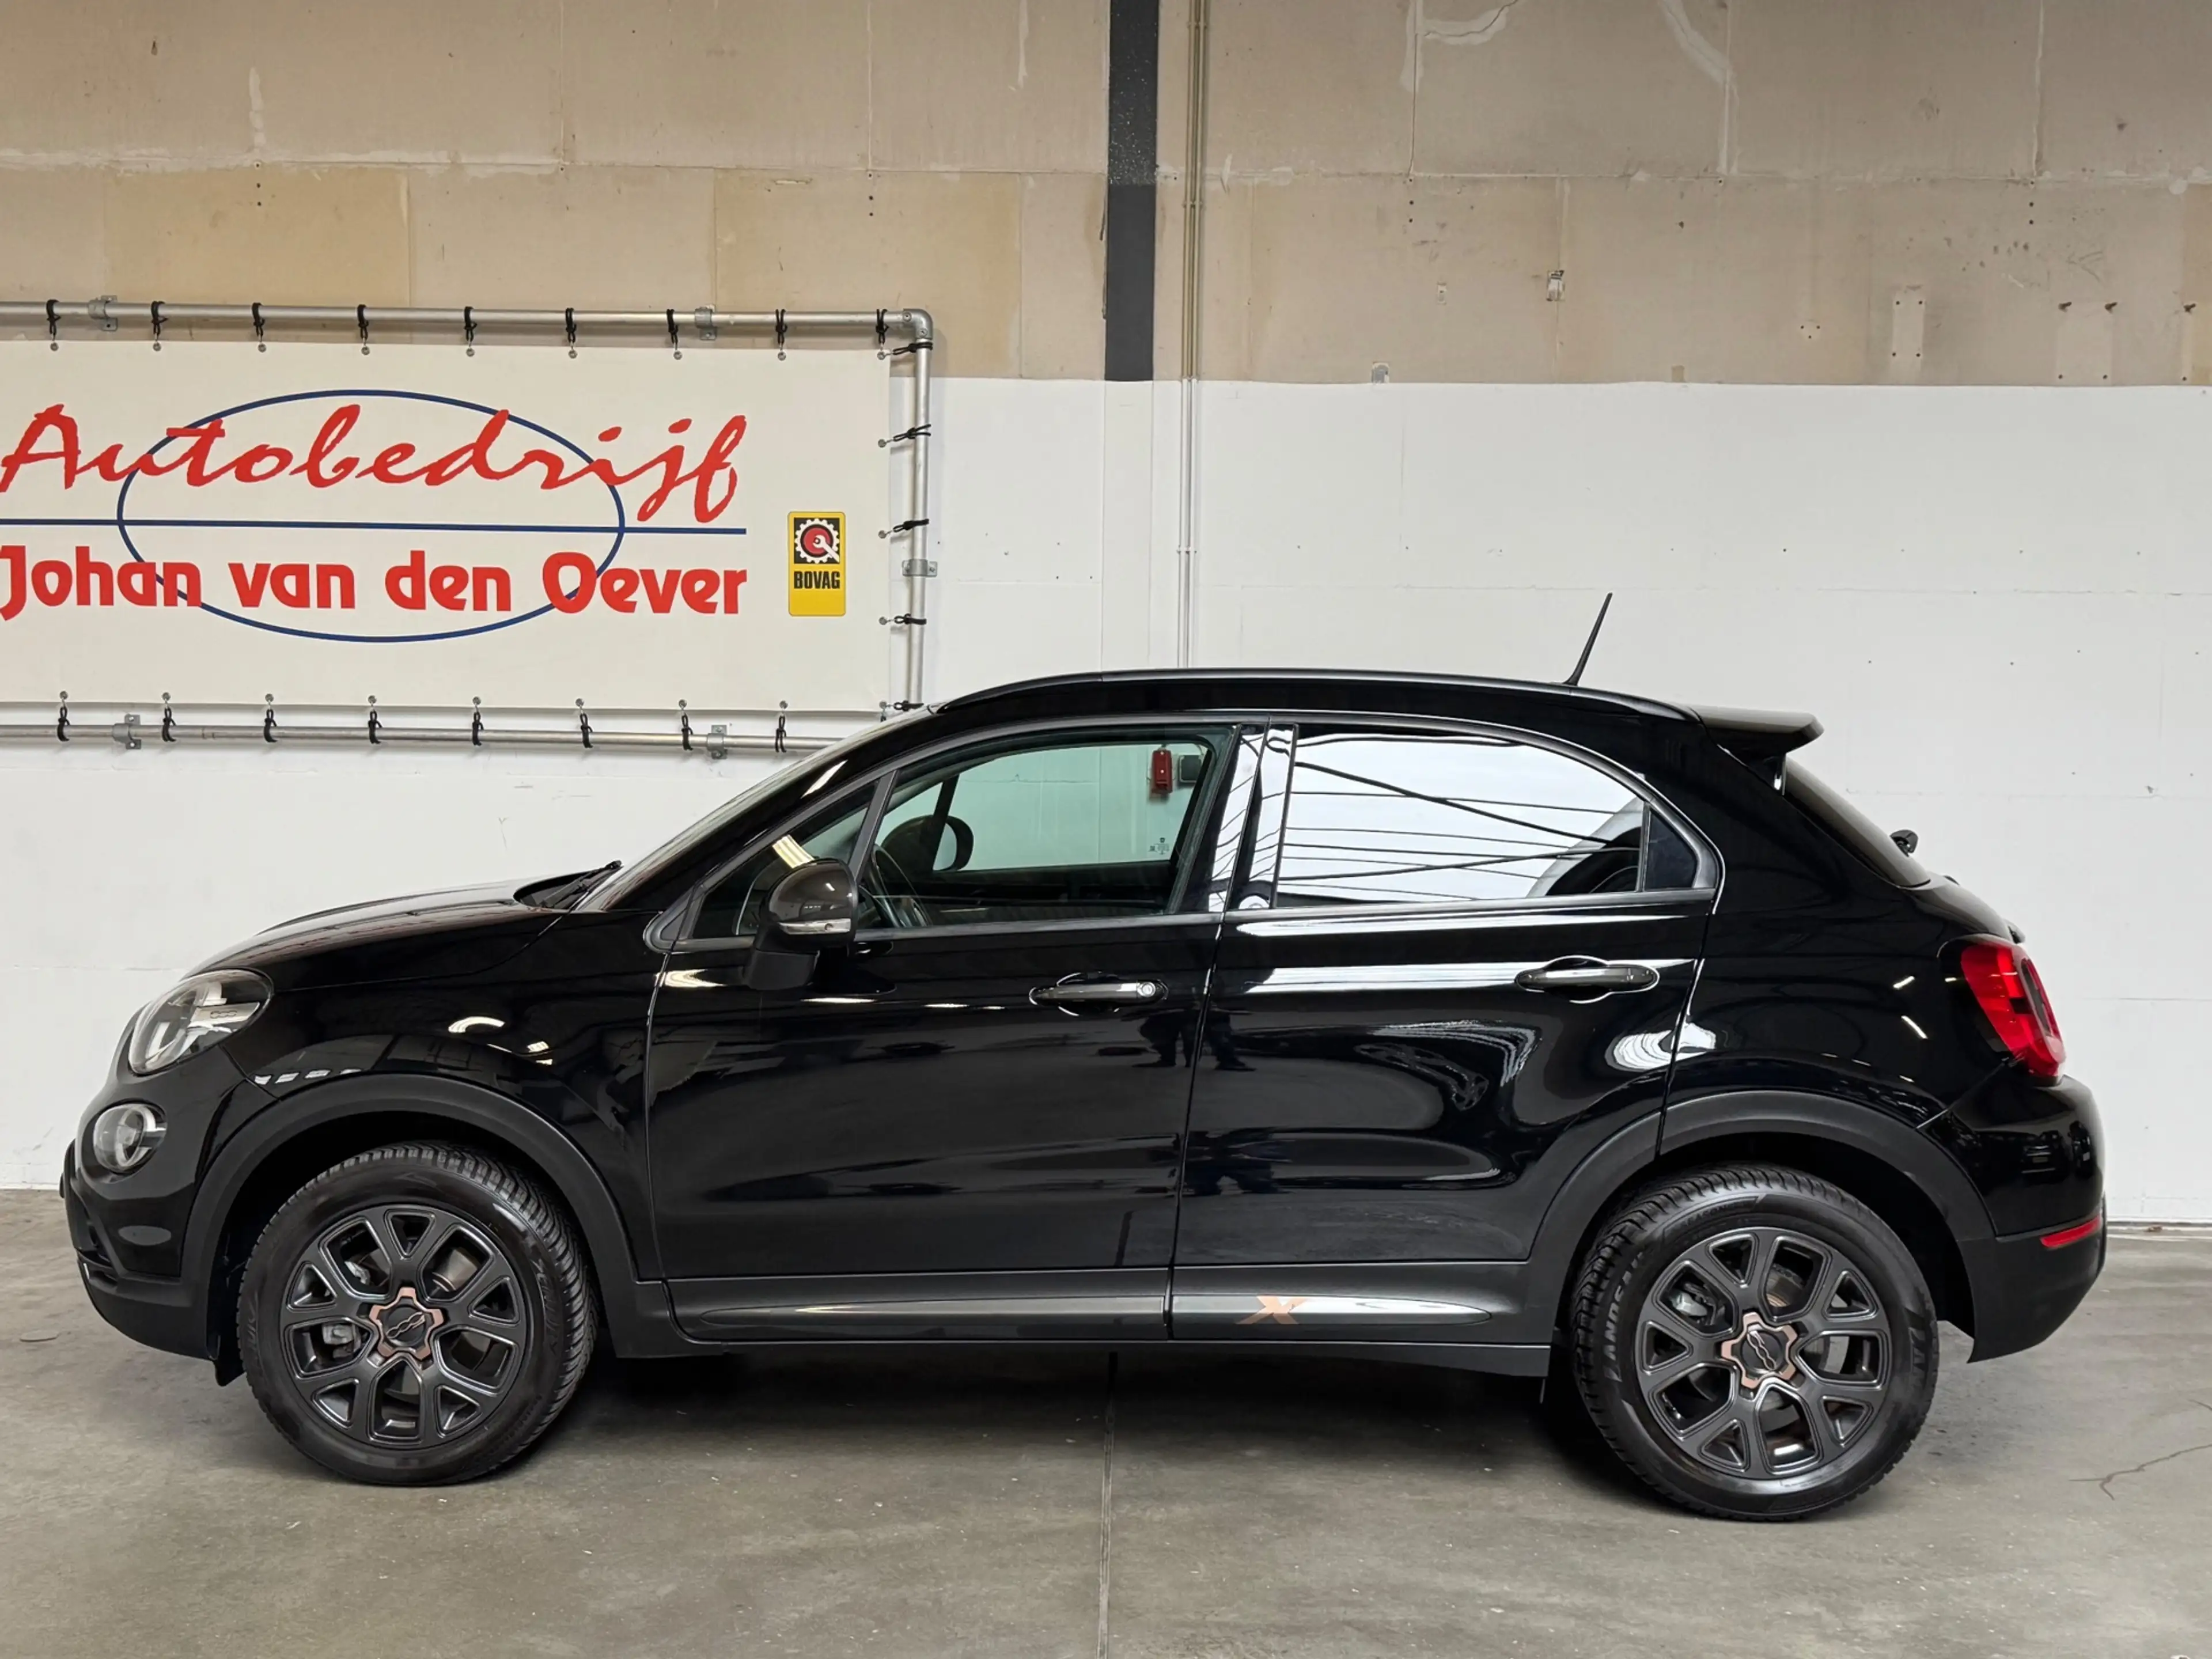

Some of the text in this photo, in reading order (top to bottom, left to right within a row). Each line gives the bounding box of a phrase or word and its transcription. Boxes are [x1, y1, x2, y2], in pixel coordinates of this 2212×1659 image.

[0, 404, 747, 524] Autobedrijf
[0, 545, 748, 620] Johan van den Oever
[793, 570, 840, 589] BOVAG
